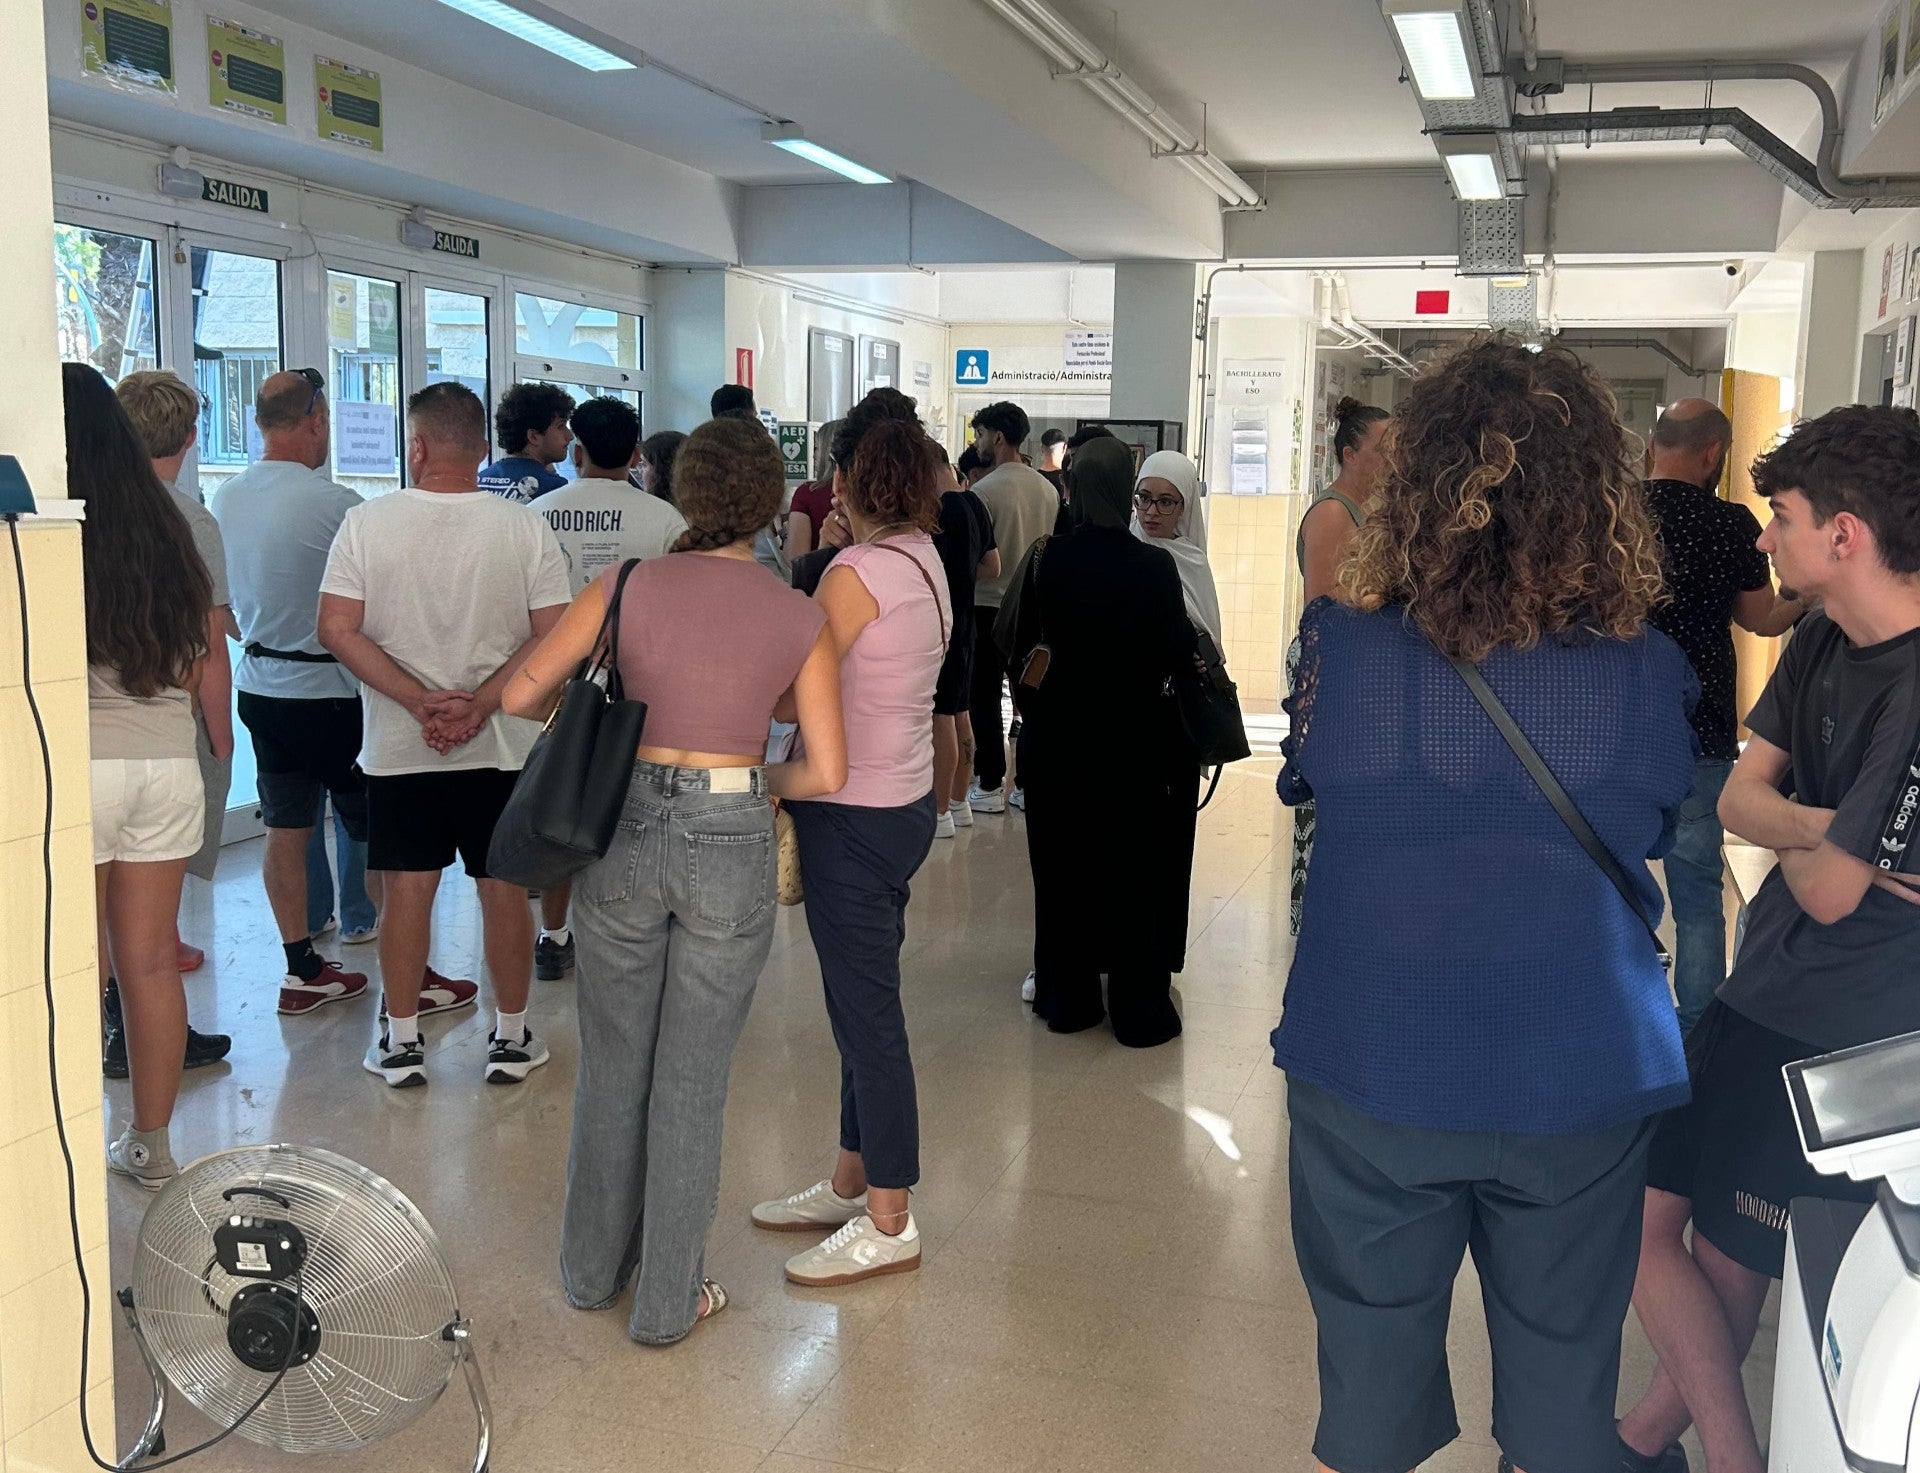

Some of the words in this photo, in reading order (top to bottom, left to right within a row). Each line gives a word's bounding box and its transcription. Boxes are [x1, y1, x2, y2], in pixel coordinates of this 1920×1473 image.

[208, 180, 262, 210] SALIDA
[436, 232, 475, 256] SALIDA
[991, 370, 1112, 381] Administració/Administra
[1226, 370, 1282, 378] BACHILLERATO
[1245, 387, 1260, 395] ESO
[781, 426, 806, 436] AED
[1893, 785, 1919, 831] adidas
[1736, 1190, 1788, 1231] HOODRI
